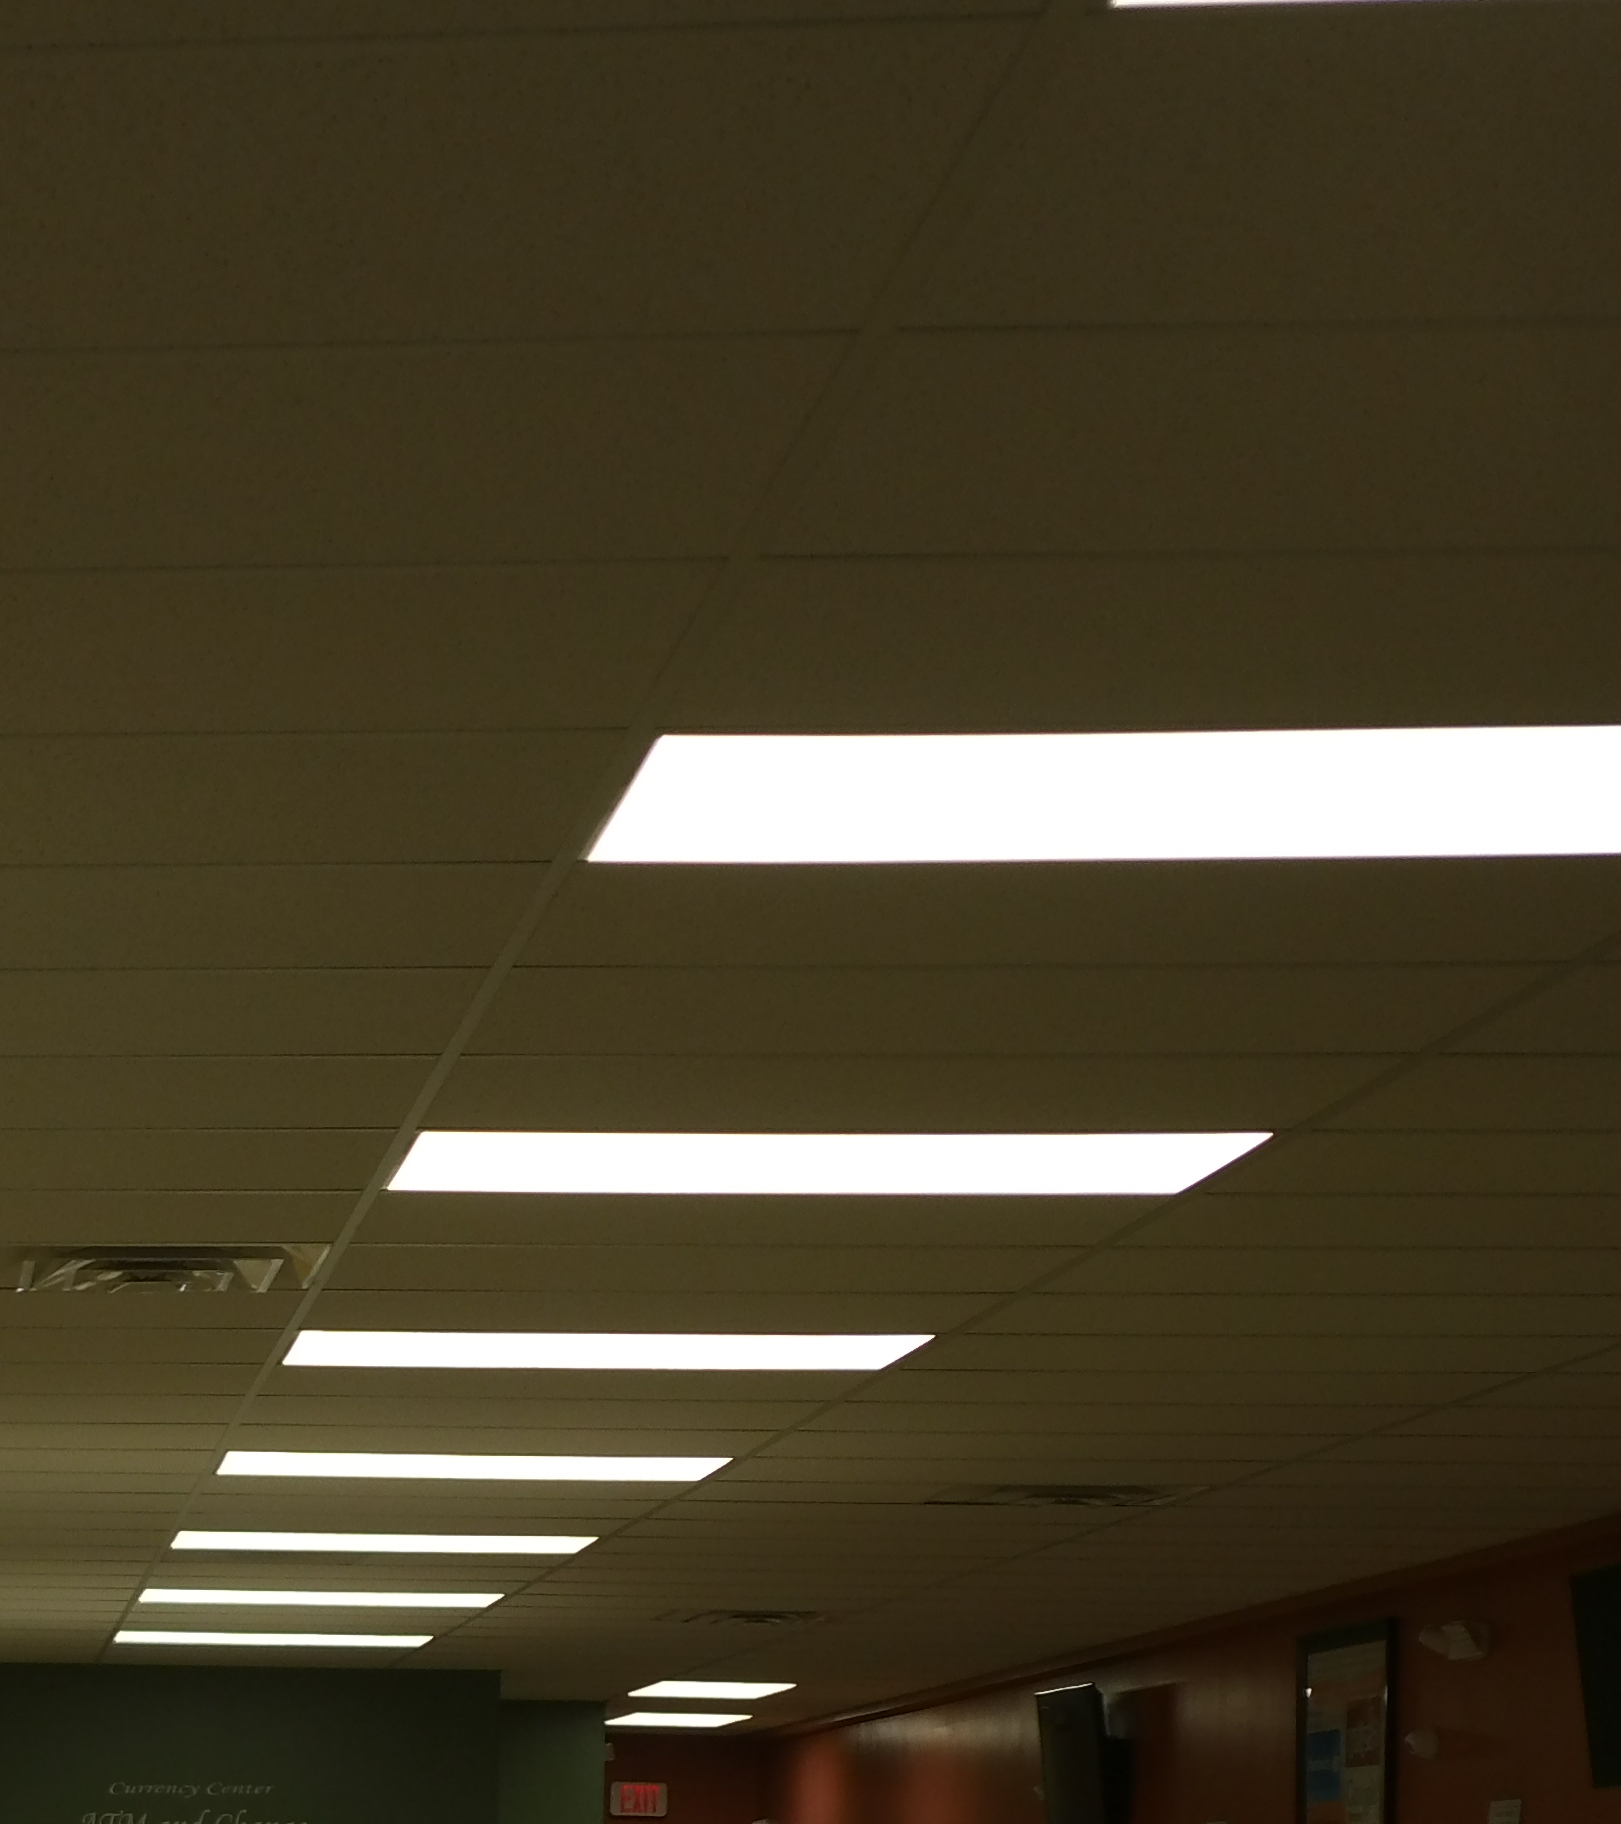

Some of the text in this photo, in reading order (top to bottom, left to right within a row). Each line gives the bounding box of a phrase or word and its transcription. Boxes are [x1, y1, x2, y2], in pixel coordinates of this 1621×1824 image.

[109, 1781, 275, 1798] Currency Center
[620, 1784, 660, 1813] EXIT
